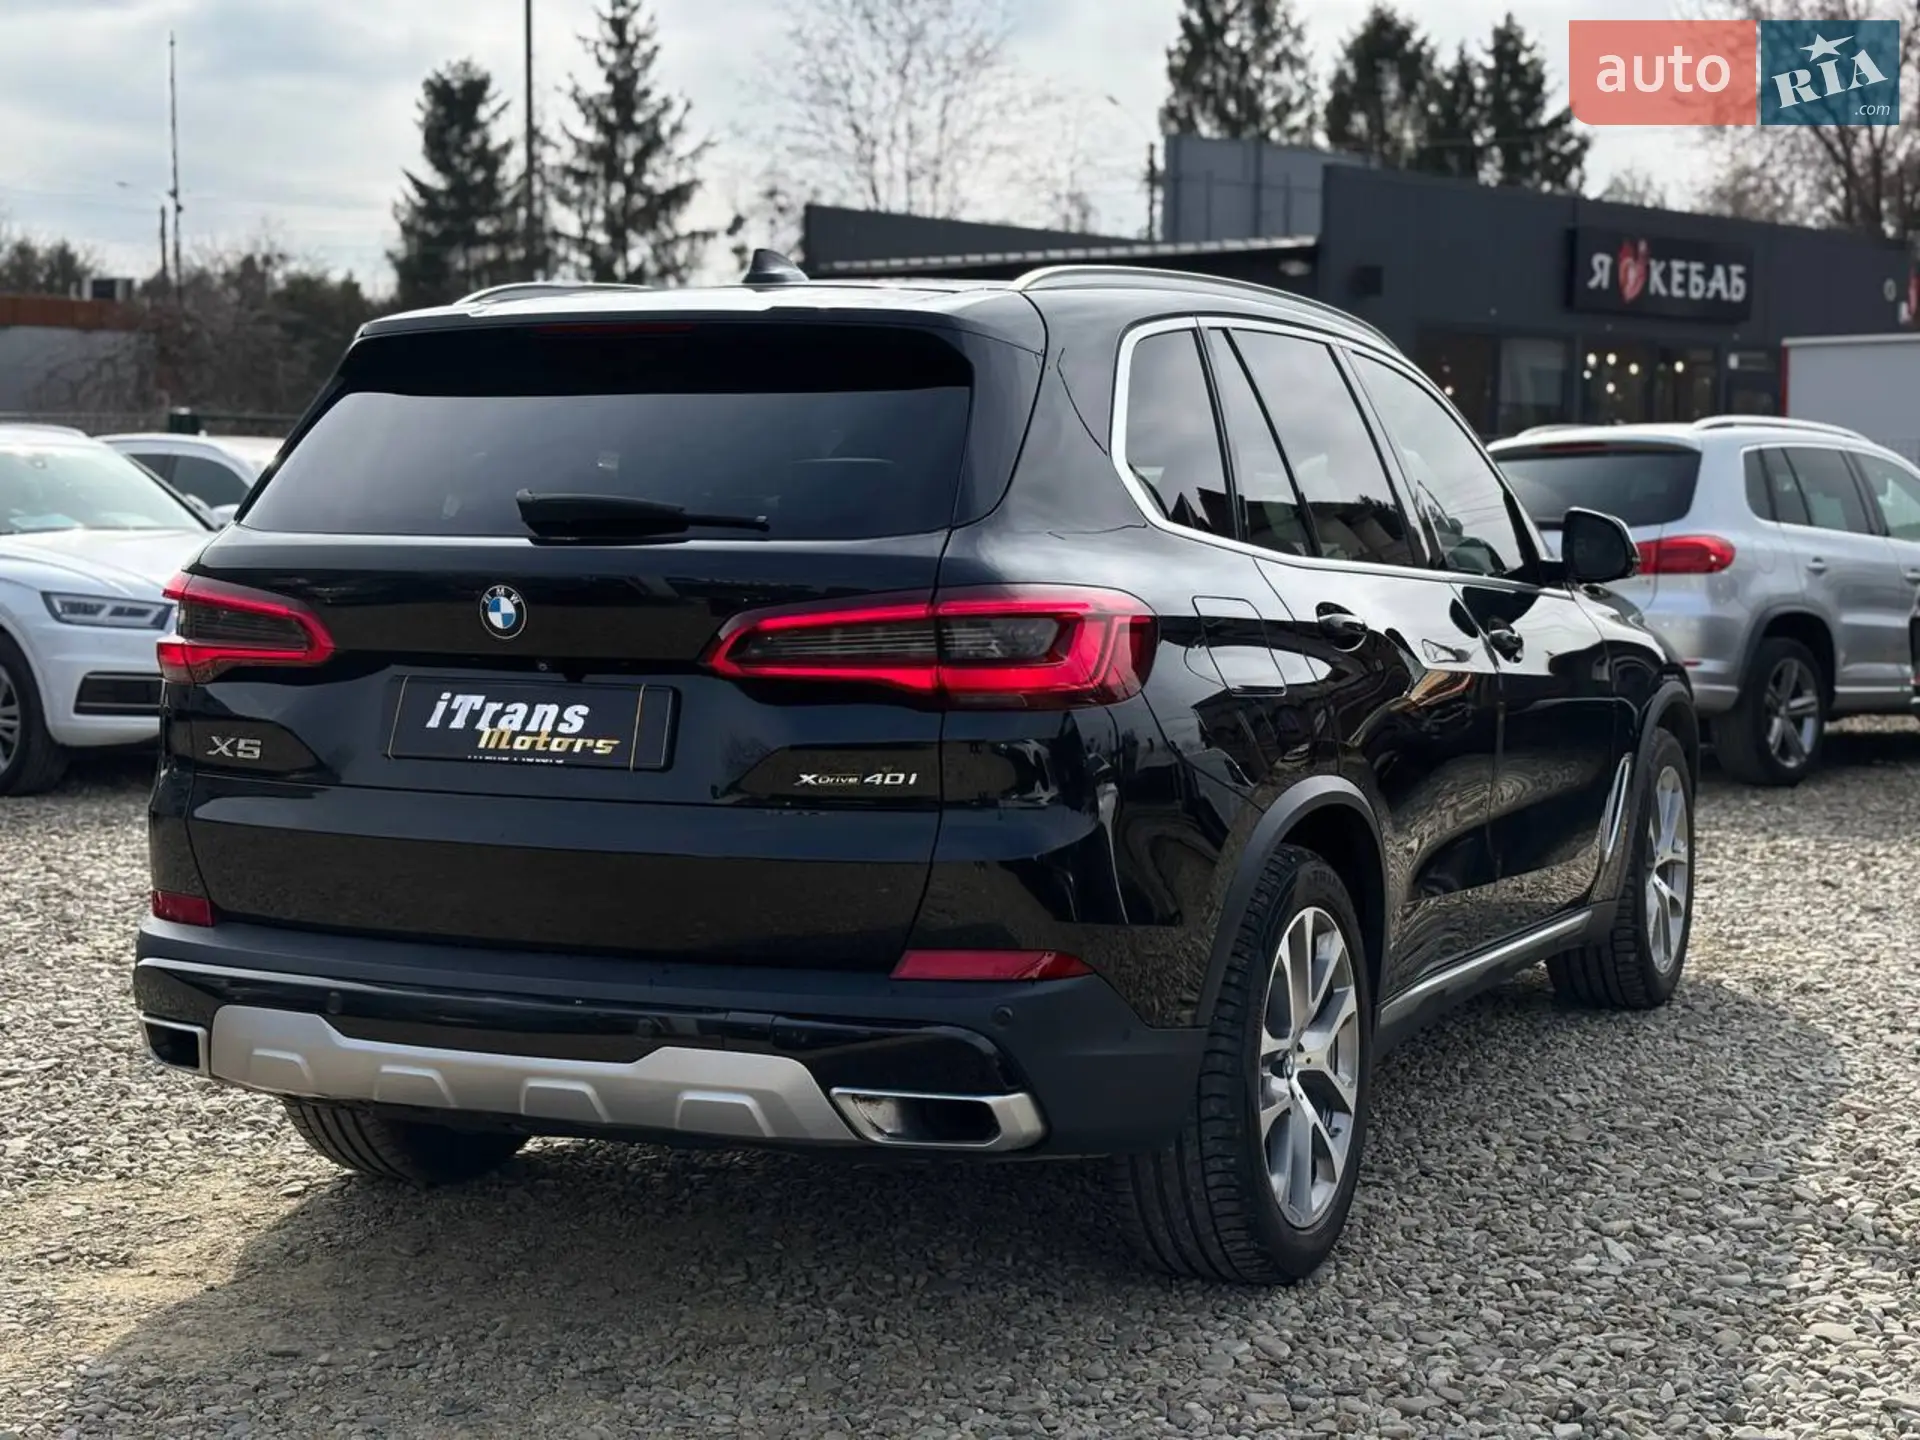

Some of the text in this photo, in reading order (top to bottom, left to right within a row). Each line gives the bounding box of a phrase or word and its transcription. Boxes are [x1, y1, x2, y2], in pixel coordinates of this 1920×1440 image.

[1587, 252, 1747, 302] Я КЕБАБ
[425, 692, 590, 734] iTrans
[206, 735, 262, 760] X5
[477, 727, 620, 754] Motors
